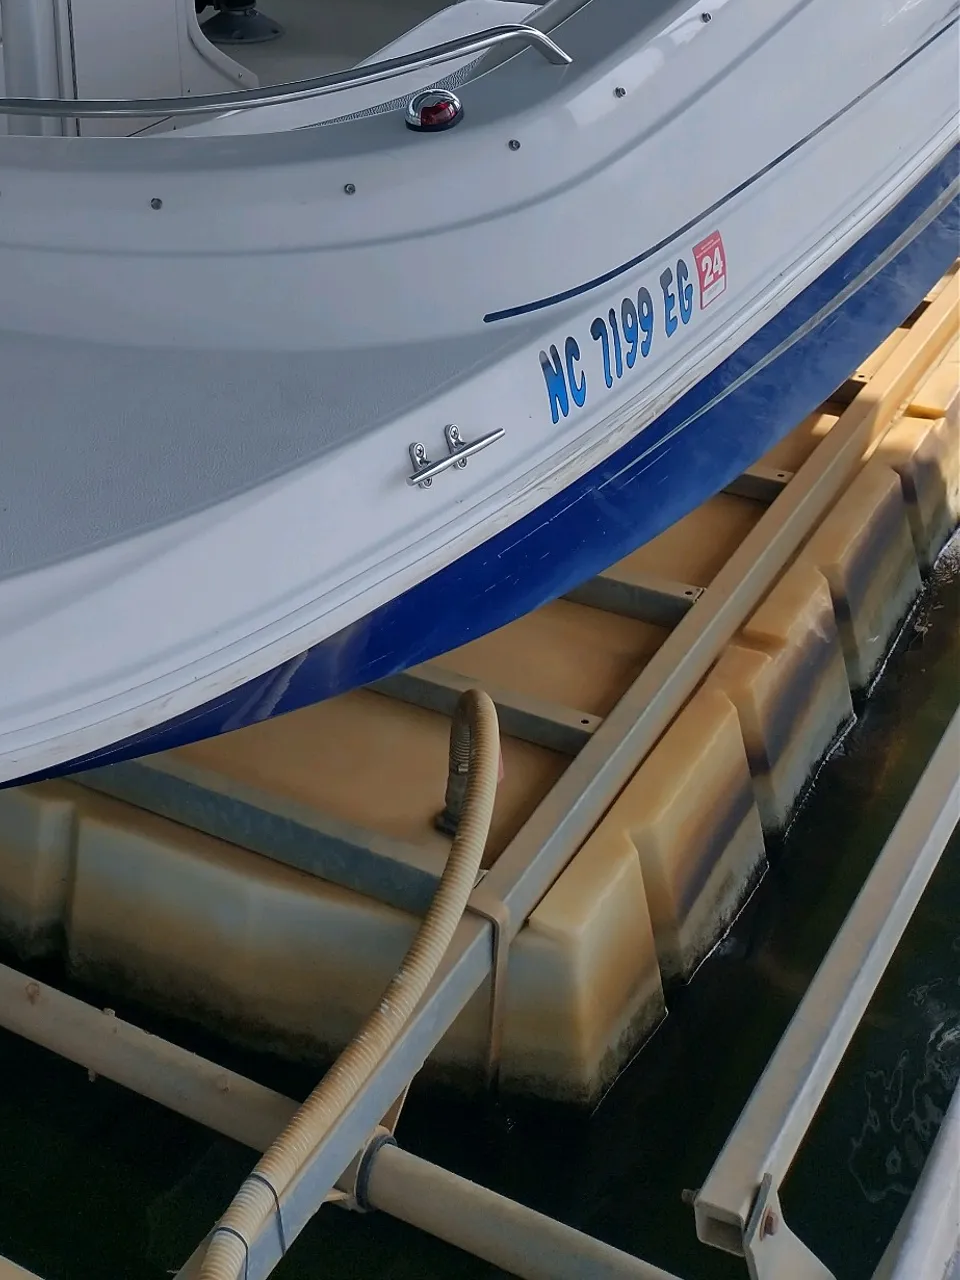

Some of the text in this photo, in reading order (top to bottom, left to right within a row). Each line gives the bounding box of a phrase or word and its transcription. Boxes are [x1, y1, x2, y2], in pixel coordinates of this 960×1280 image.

[702, 246, 723, 287] 24
[539, 258, 693, 424] NC 7199 EG
